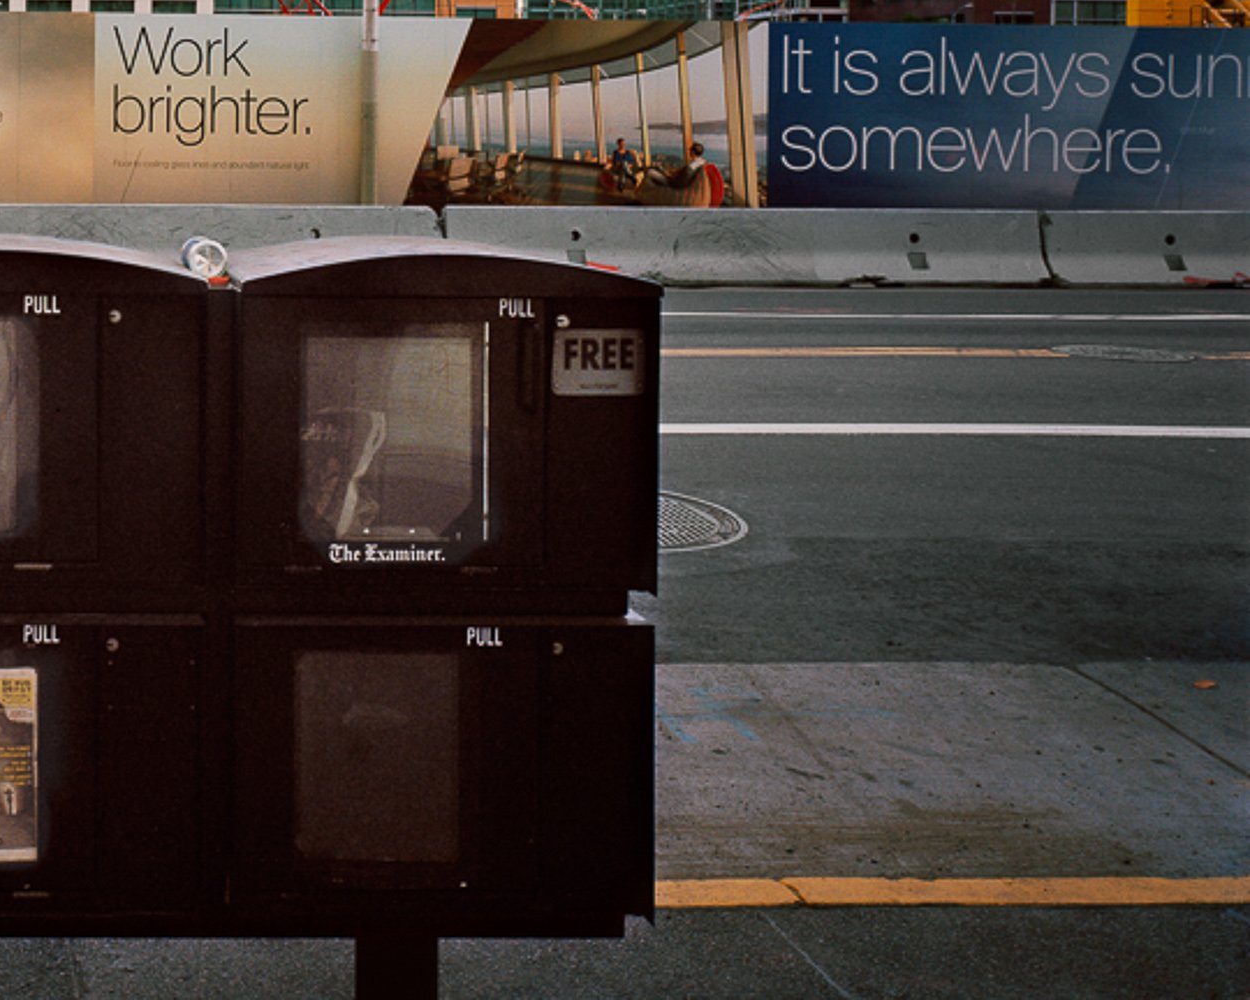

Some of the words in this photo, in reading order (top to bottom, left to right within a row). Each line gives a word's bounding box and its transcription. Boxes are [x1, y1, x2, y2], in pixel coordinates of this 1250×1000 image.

[113, 26, 250, 77] Work
[783, 35, 813, 94] It
[833, 35, 879, 96] is
[900, 36, 1111, 111] always
[1131, 53, 1250, 99] sun
[113, 84, 311, 146] brighter.
[23, 295, 61, 314] PULL
[498, 298, 535, 318] PULL
[564, 338, 635, 371] FREE
[329, 543, 362, 563] The
[364, 543, 446, 562] Examiner.
[23, 624, 61, 644] PULL
[466, 627, 503, 647] PULL
